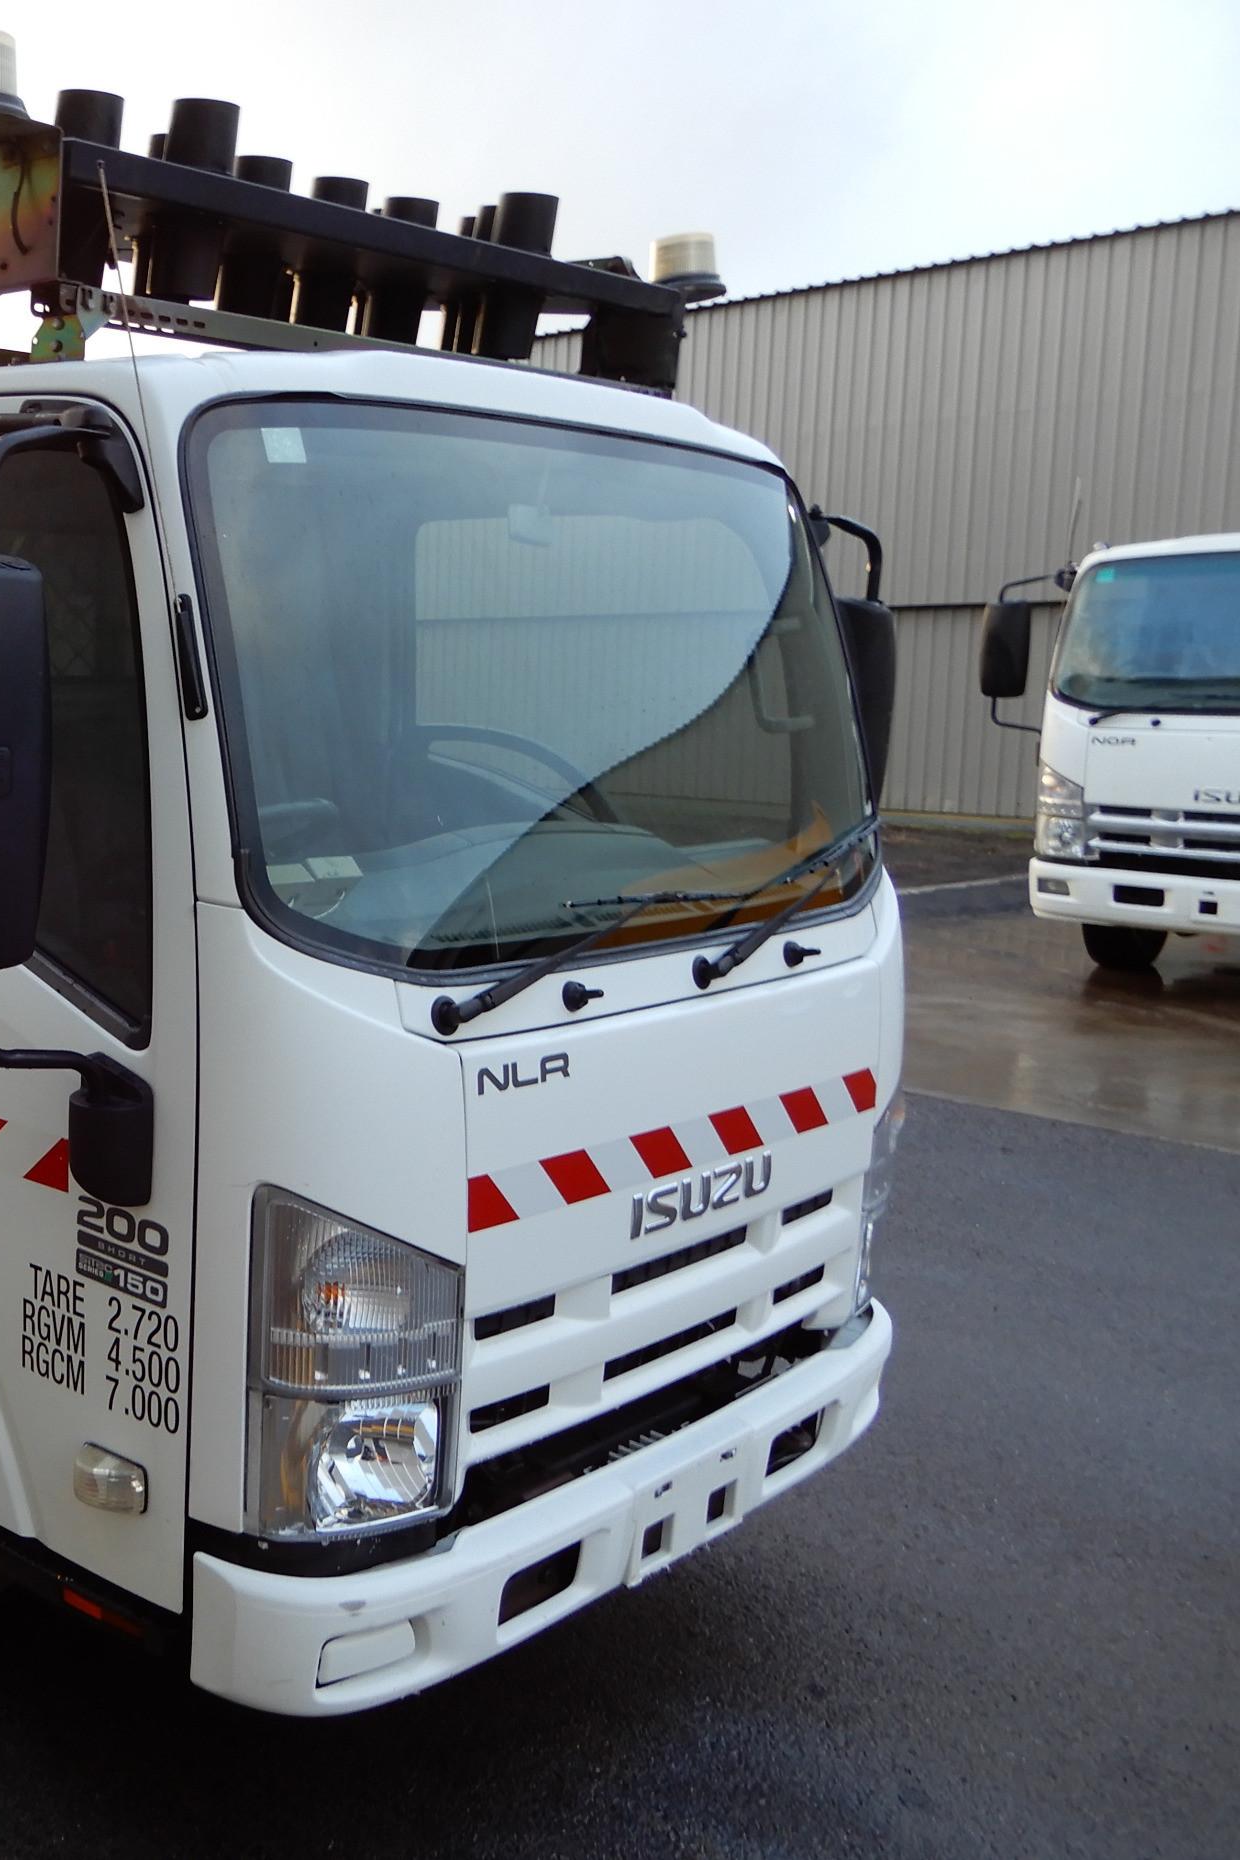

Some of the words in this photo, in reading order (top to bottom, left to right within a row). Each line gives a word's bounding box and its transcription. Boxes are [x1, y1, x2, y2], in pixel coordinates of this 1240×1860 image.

[477, 1052, 570, 1096] NLR
[77, 1195, 169, 1256] 200
[630, 1150, 772, 1240] ISUZU
[97, 1241, 146, 1266] SHORT
[113, 1268, 164, 1303] 150
[29, 1263, 85, 1318] TARE
[107, 1296, 179, 1352] 2.720
[22, 1298, 86, 1358] RGVM
[107, 1337, 180, 1394] 4.500
[21, 1334, 85, 1395] RGCM
[105, 1375, 180, 1434] 7.000
